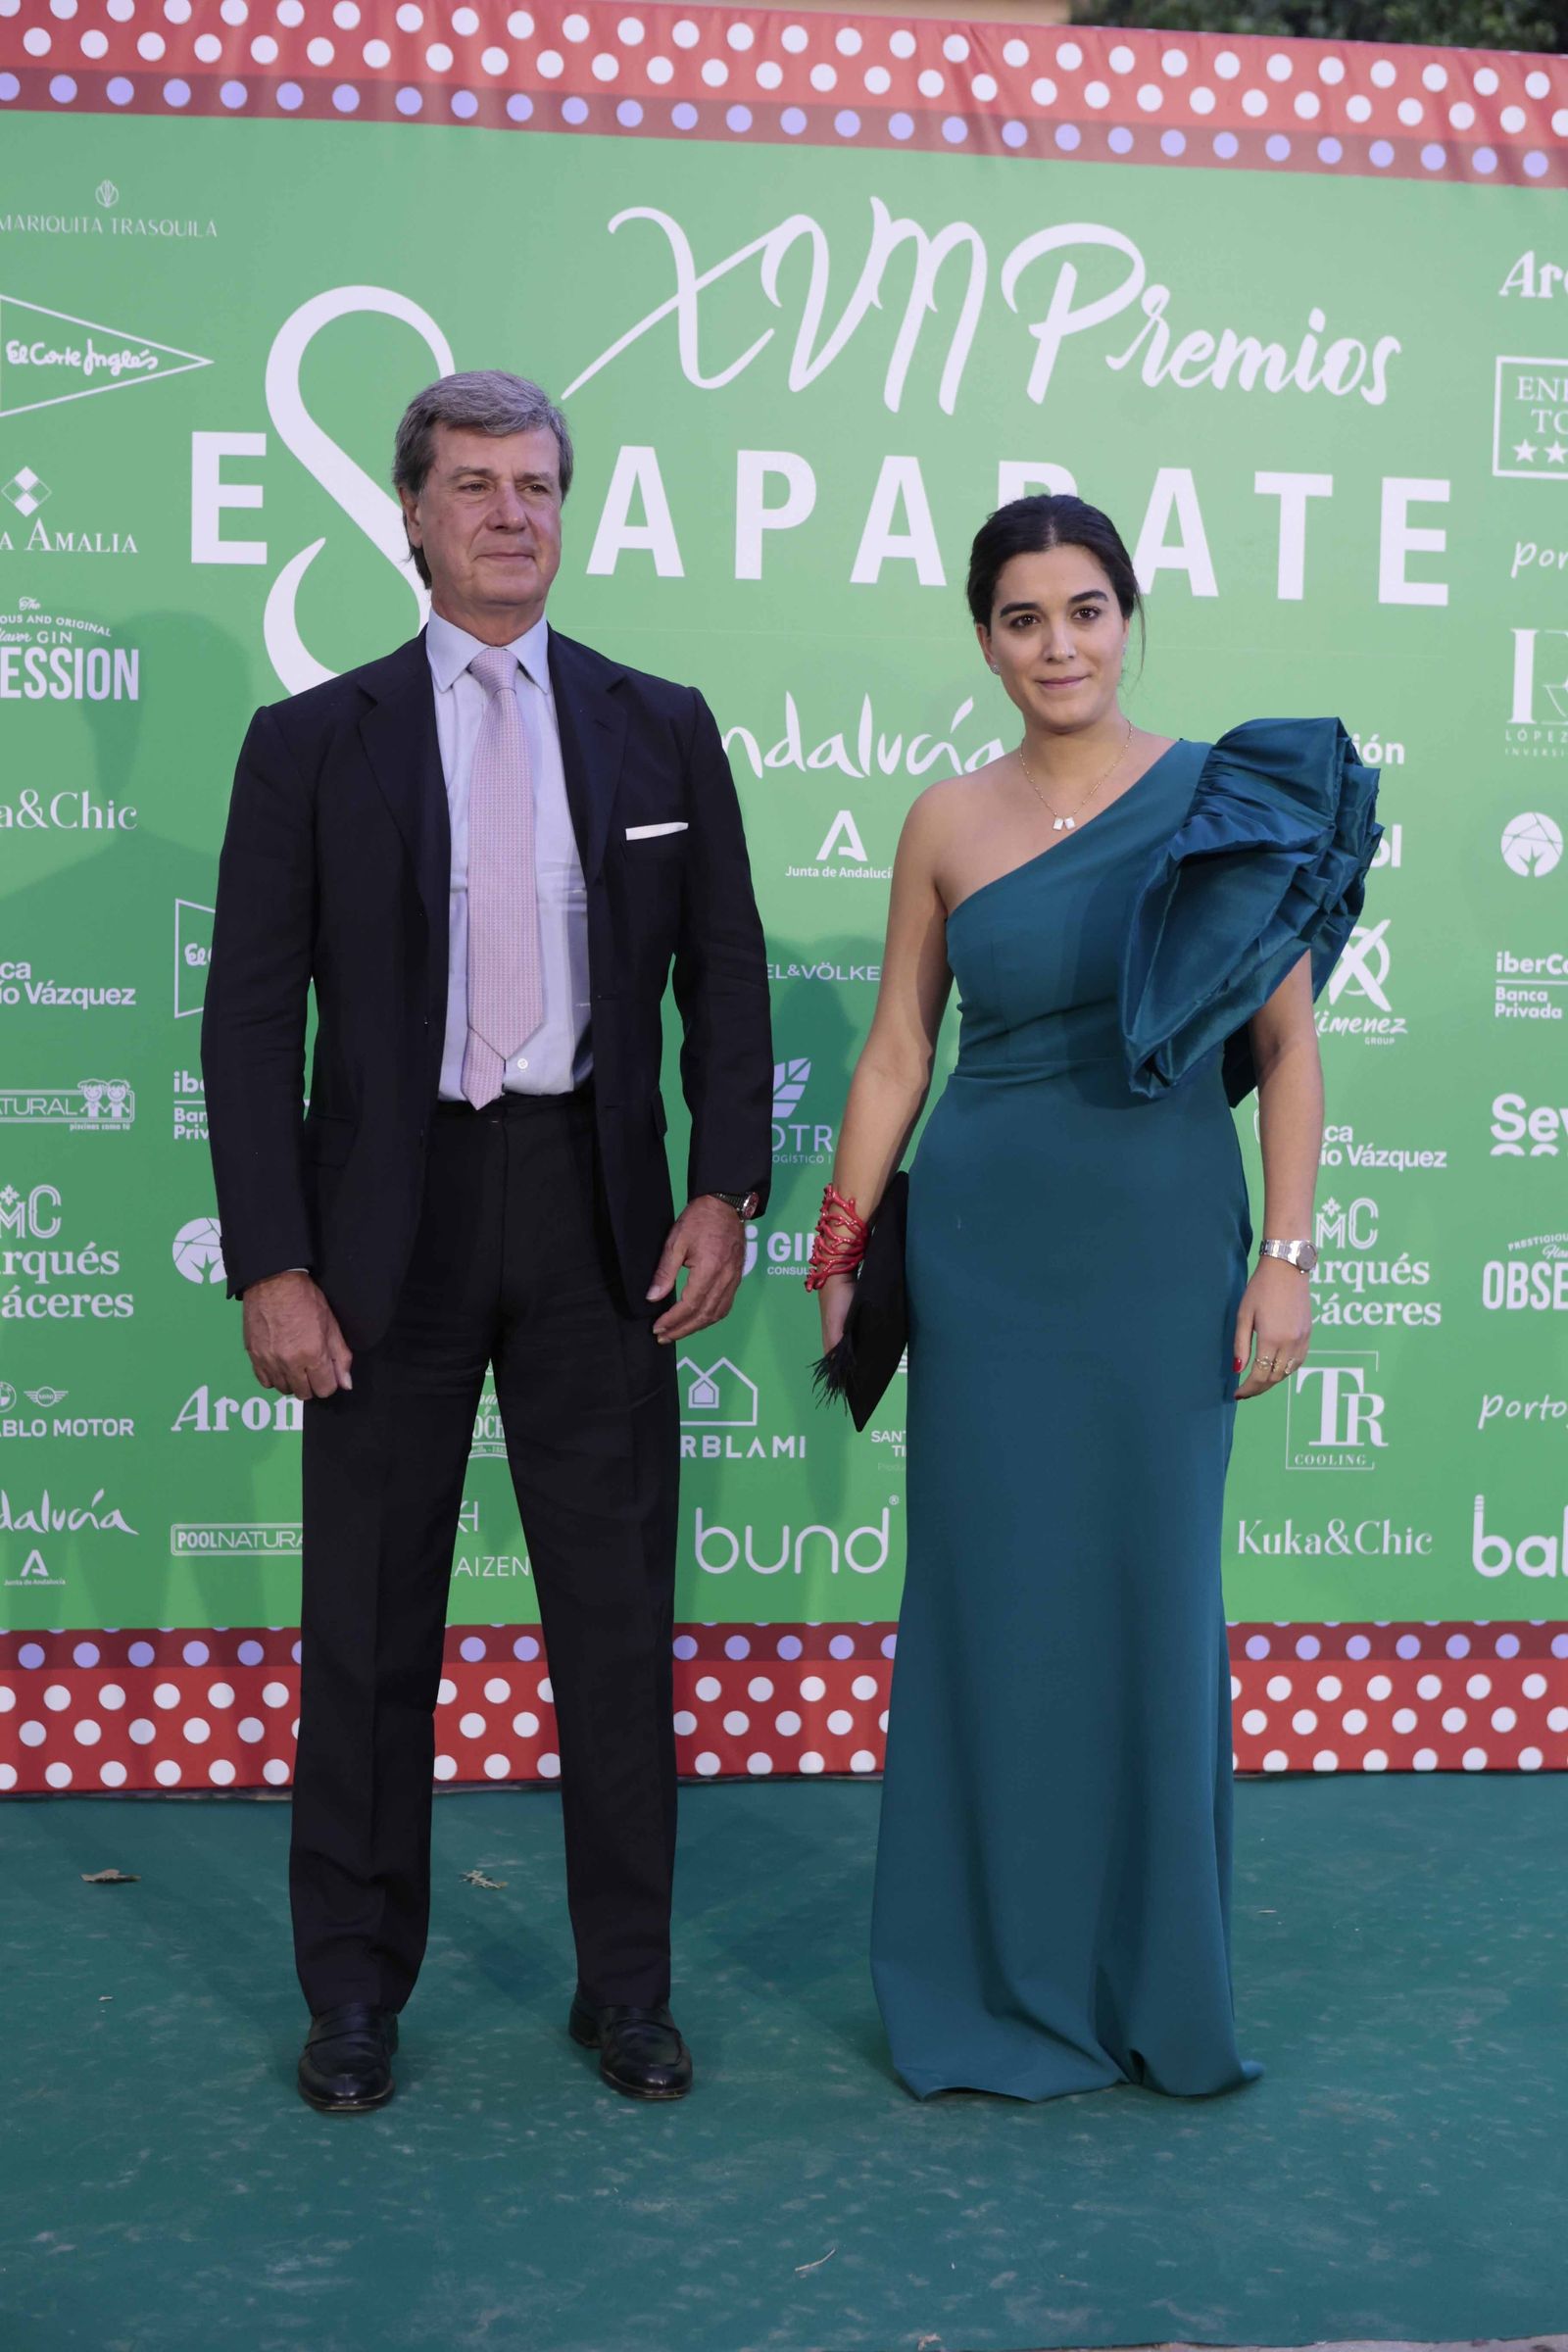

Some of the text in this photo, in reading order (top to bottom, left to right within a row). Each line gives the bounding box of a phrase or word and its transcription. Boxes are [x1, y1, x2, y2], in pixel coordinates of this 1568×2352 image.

[111, 217, 219, 238] TRASQUILA
[1498, 250, 1568, 299] Ar
[1001, 222, 1402, 406] Premios
[29, 341, 82, 367] Corte
[24, 516, 139, 554] AMALIA
[0, 614, 113, 638] OUS AND ORIGINAL
[36, 631, 74, 644] GIN
[0, 646, 140, 701] ESSION
[720, 690, 1006, 780] ndalucía
[0, 788, 138, 830] a&Chic
[785, 865, 894, 880] Junta de Andalucí
[24, 980, 137, 1010] Vázquez
[1495, 986, 1548, 1004] Banca
[1494, 1003, 1563, 1020] Privada
[1364, 1036, 1396, 1046] GROUP
[0, 1098, 77, 1115] TURAL
[771, 1154, 825, 1165] OGÍSTICO
[1347, 1144, 1447, 1172] Vázquez
[0, 1241, 120, 1285] rqués
[1482, 1260, 1568, 1311] OBSE
[0, 1284, 134, 1319] áceres
[0, 1417, 135, 1438] BLO MOTOR
[680, 1435, 807, 1459] RBLAMI
[1294, 1452, 1368, 1466] COOLING
[0, 1488, 140, 1537] dalucía
[177, 1531, 303, 1548] POOLNATURA
[1238, 1518, 1433, 1556] Kuka&Chic
[454, 1556, 530, 1577] AIZEN
